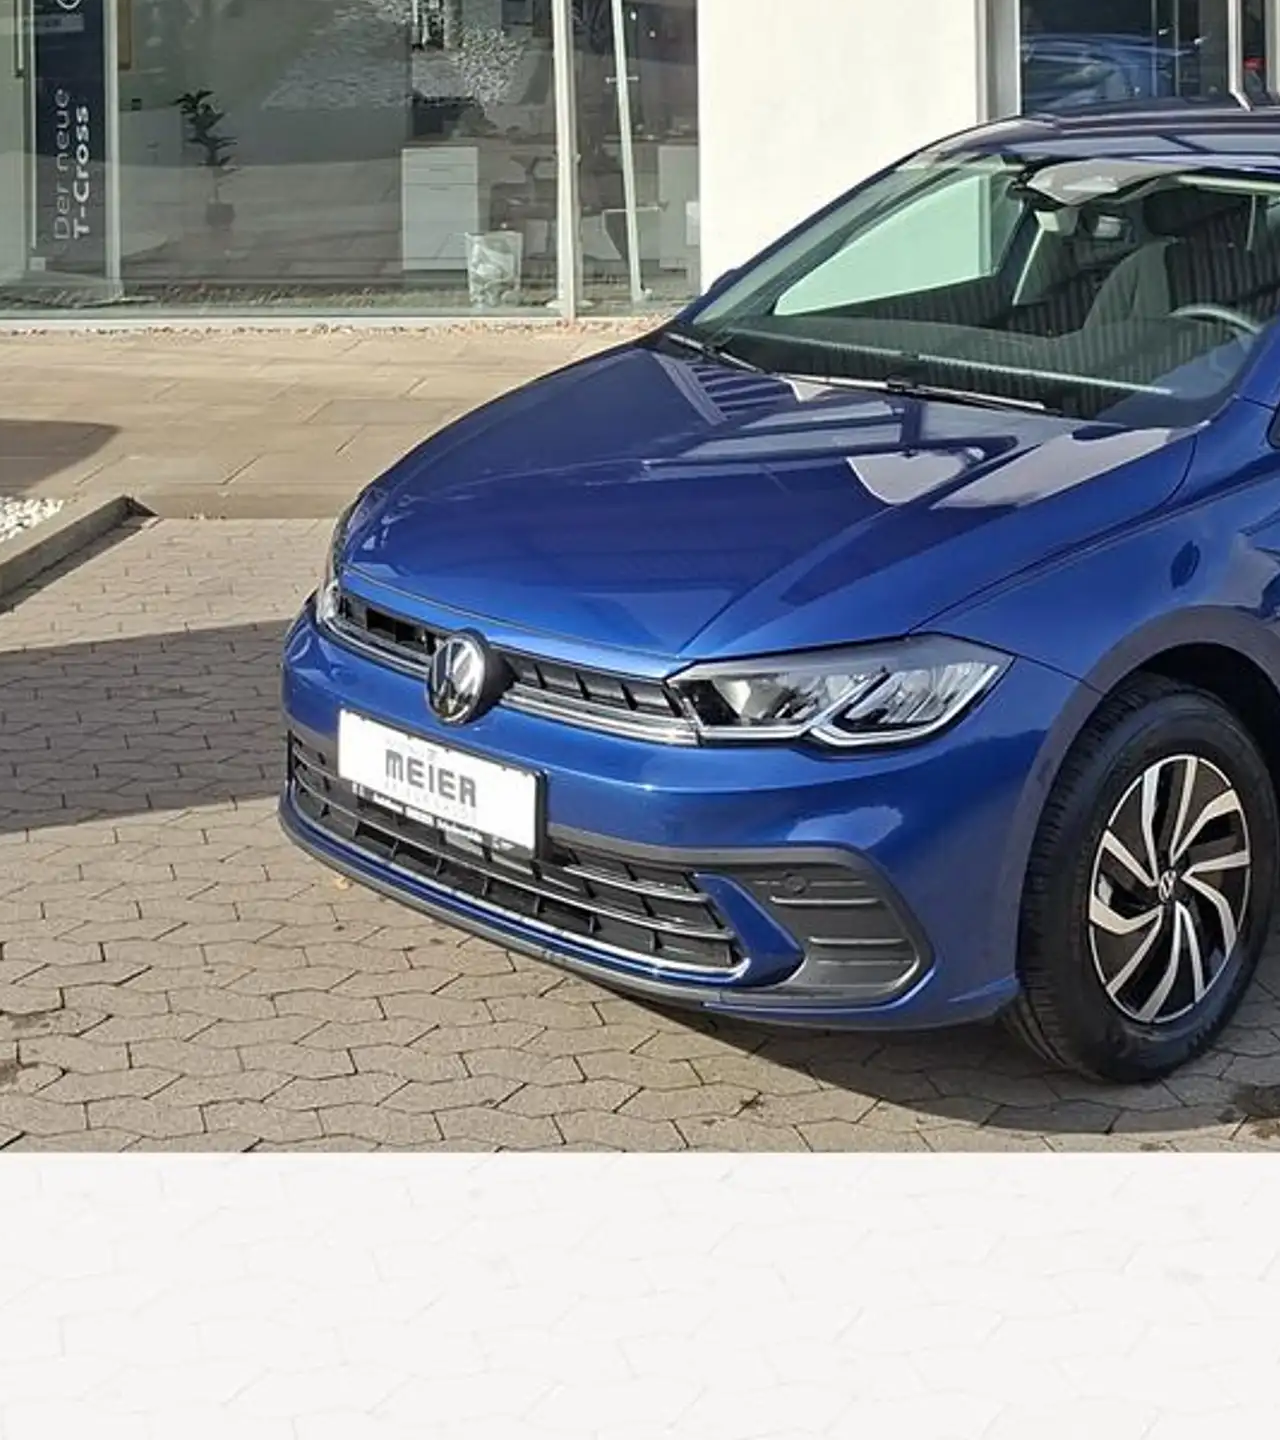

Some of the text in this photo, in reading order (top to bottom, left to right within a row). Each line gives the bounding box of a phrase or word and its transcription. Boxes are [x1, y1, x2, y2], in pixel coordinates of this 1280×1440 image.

[54, 88, 71, 240] Der neue
[73, 105, 90, 239] T-Cross
[385, 749, 476, 808] MEIER
